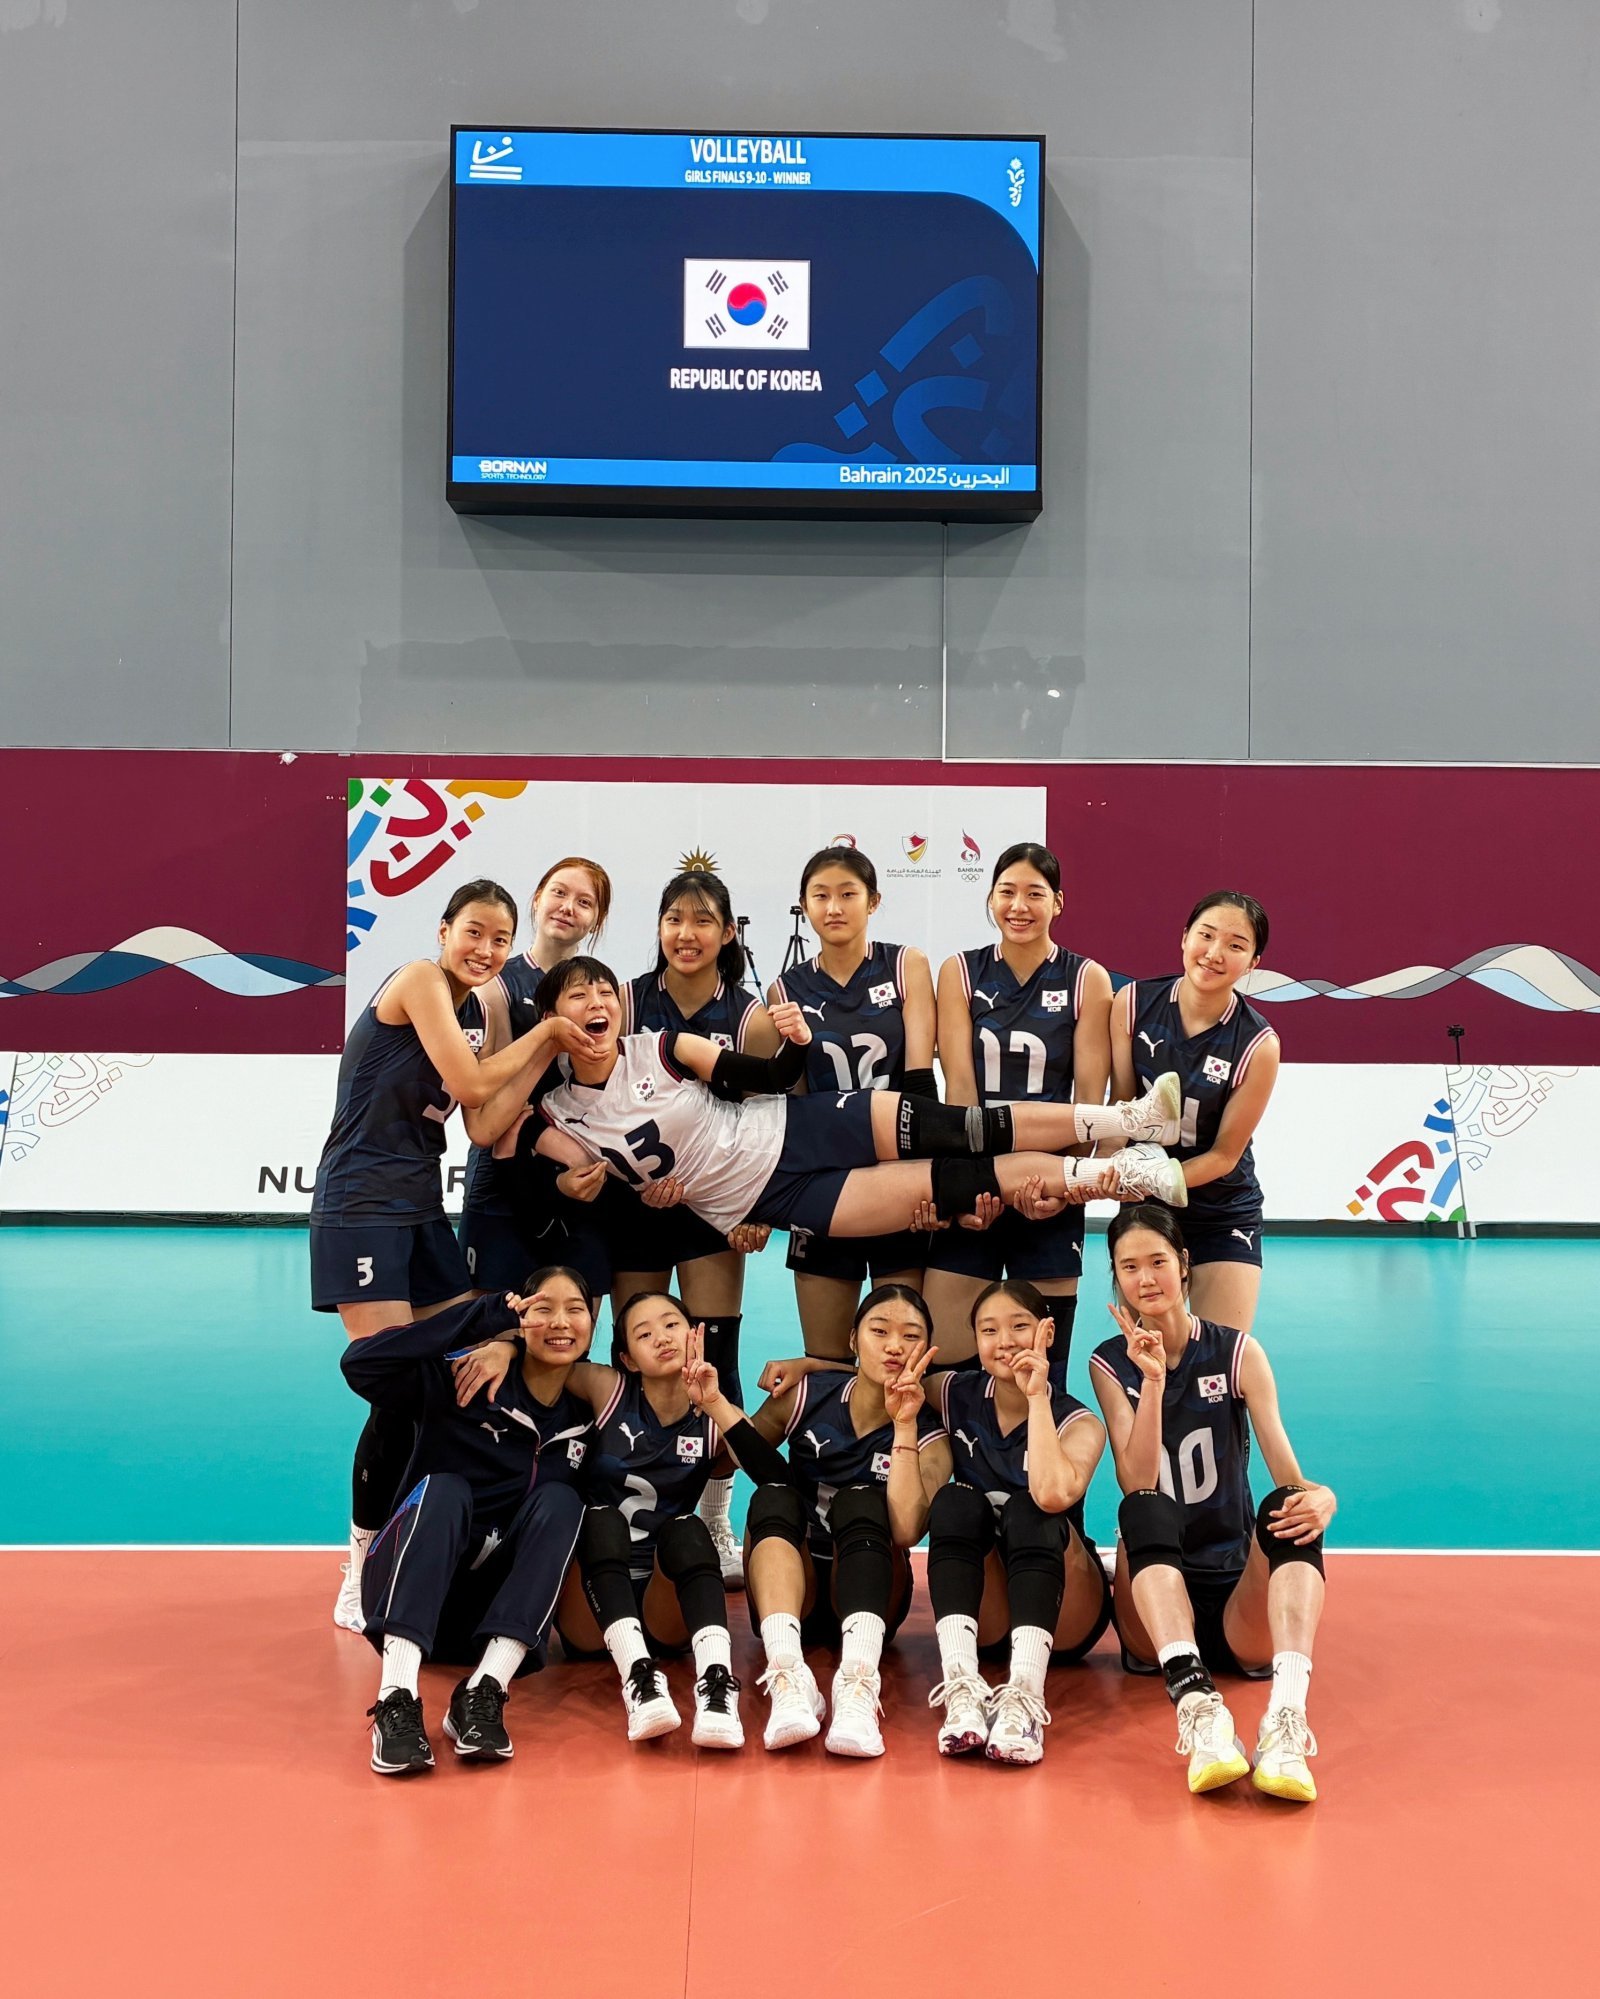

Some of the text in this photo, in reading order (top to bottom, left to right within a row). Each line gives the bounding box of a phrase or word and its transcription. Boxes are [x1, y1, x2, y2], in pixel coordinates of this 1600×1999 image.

[690, 138, 807, 165] VOLLEYBALL
[685, 169, 712, 183] GIRLS
[712, 170, 746, 184] FINALS
[746, 171, 767, 184] 9-10
[773, 171, 812, 185] WINNER
[670, 368, 823, 392] REPUBLIC OF KOREA
[478, 460, 547, 474] BORNAN
[839, 466, 1010, 489] Bahrain 2025 البحرين
[879, 1000, 893, 1009] KOR
[821, 1032, 890, 1090] 12
[979, 1027, 1047, 1094] 17
[1206, 1075, 1221, 1085] KOR
[901, 1100, 914, 1133] cep
[600, 1118, 676, 1185] 13
[356, 1256, 374, 1287] 3
[466, 1246, 477, 1275] 9
[1207, 1395, 1224, 1404] KOR
[681, 1456, 697, 1464] KOR
[876, 1472, 888, 1482] KO
[617, 1473, 658, 1542] 2
